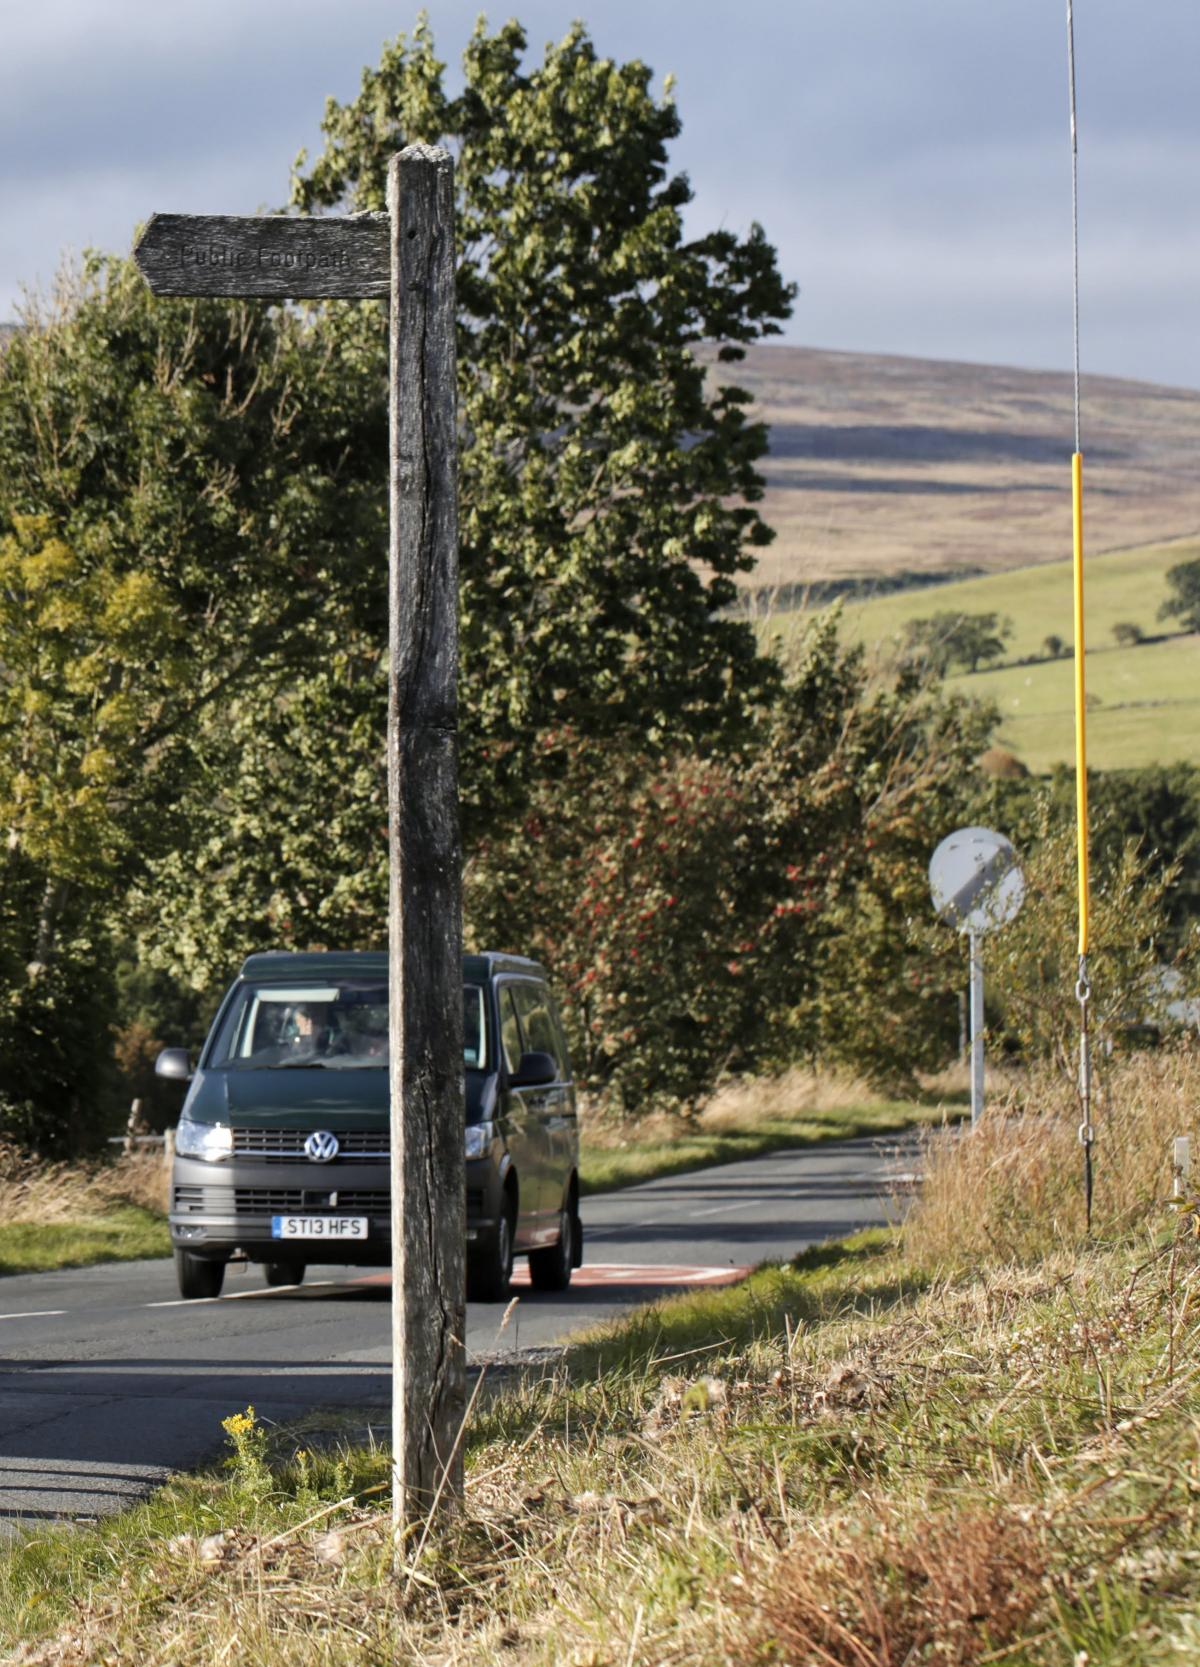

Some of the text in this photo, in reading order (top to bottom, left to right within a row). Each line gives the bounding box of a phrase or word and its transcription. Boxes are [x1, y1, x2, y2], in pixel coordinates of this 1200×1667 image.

[179, 245, 351, 273] Public Footpath
[287, 1218, 323, 1234] ST13
[329, 1219, 361, 1235] HFS
